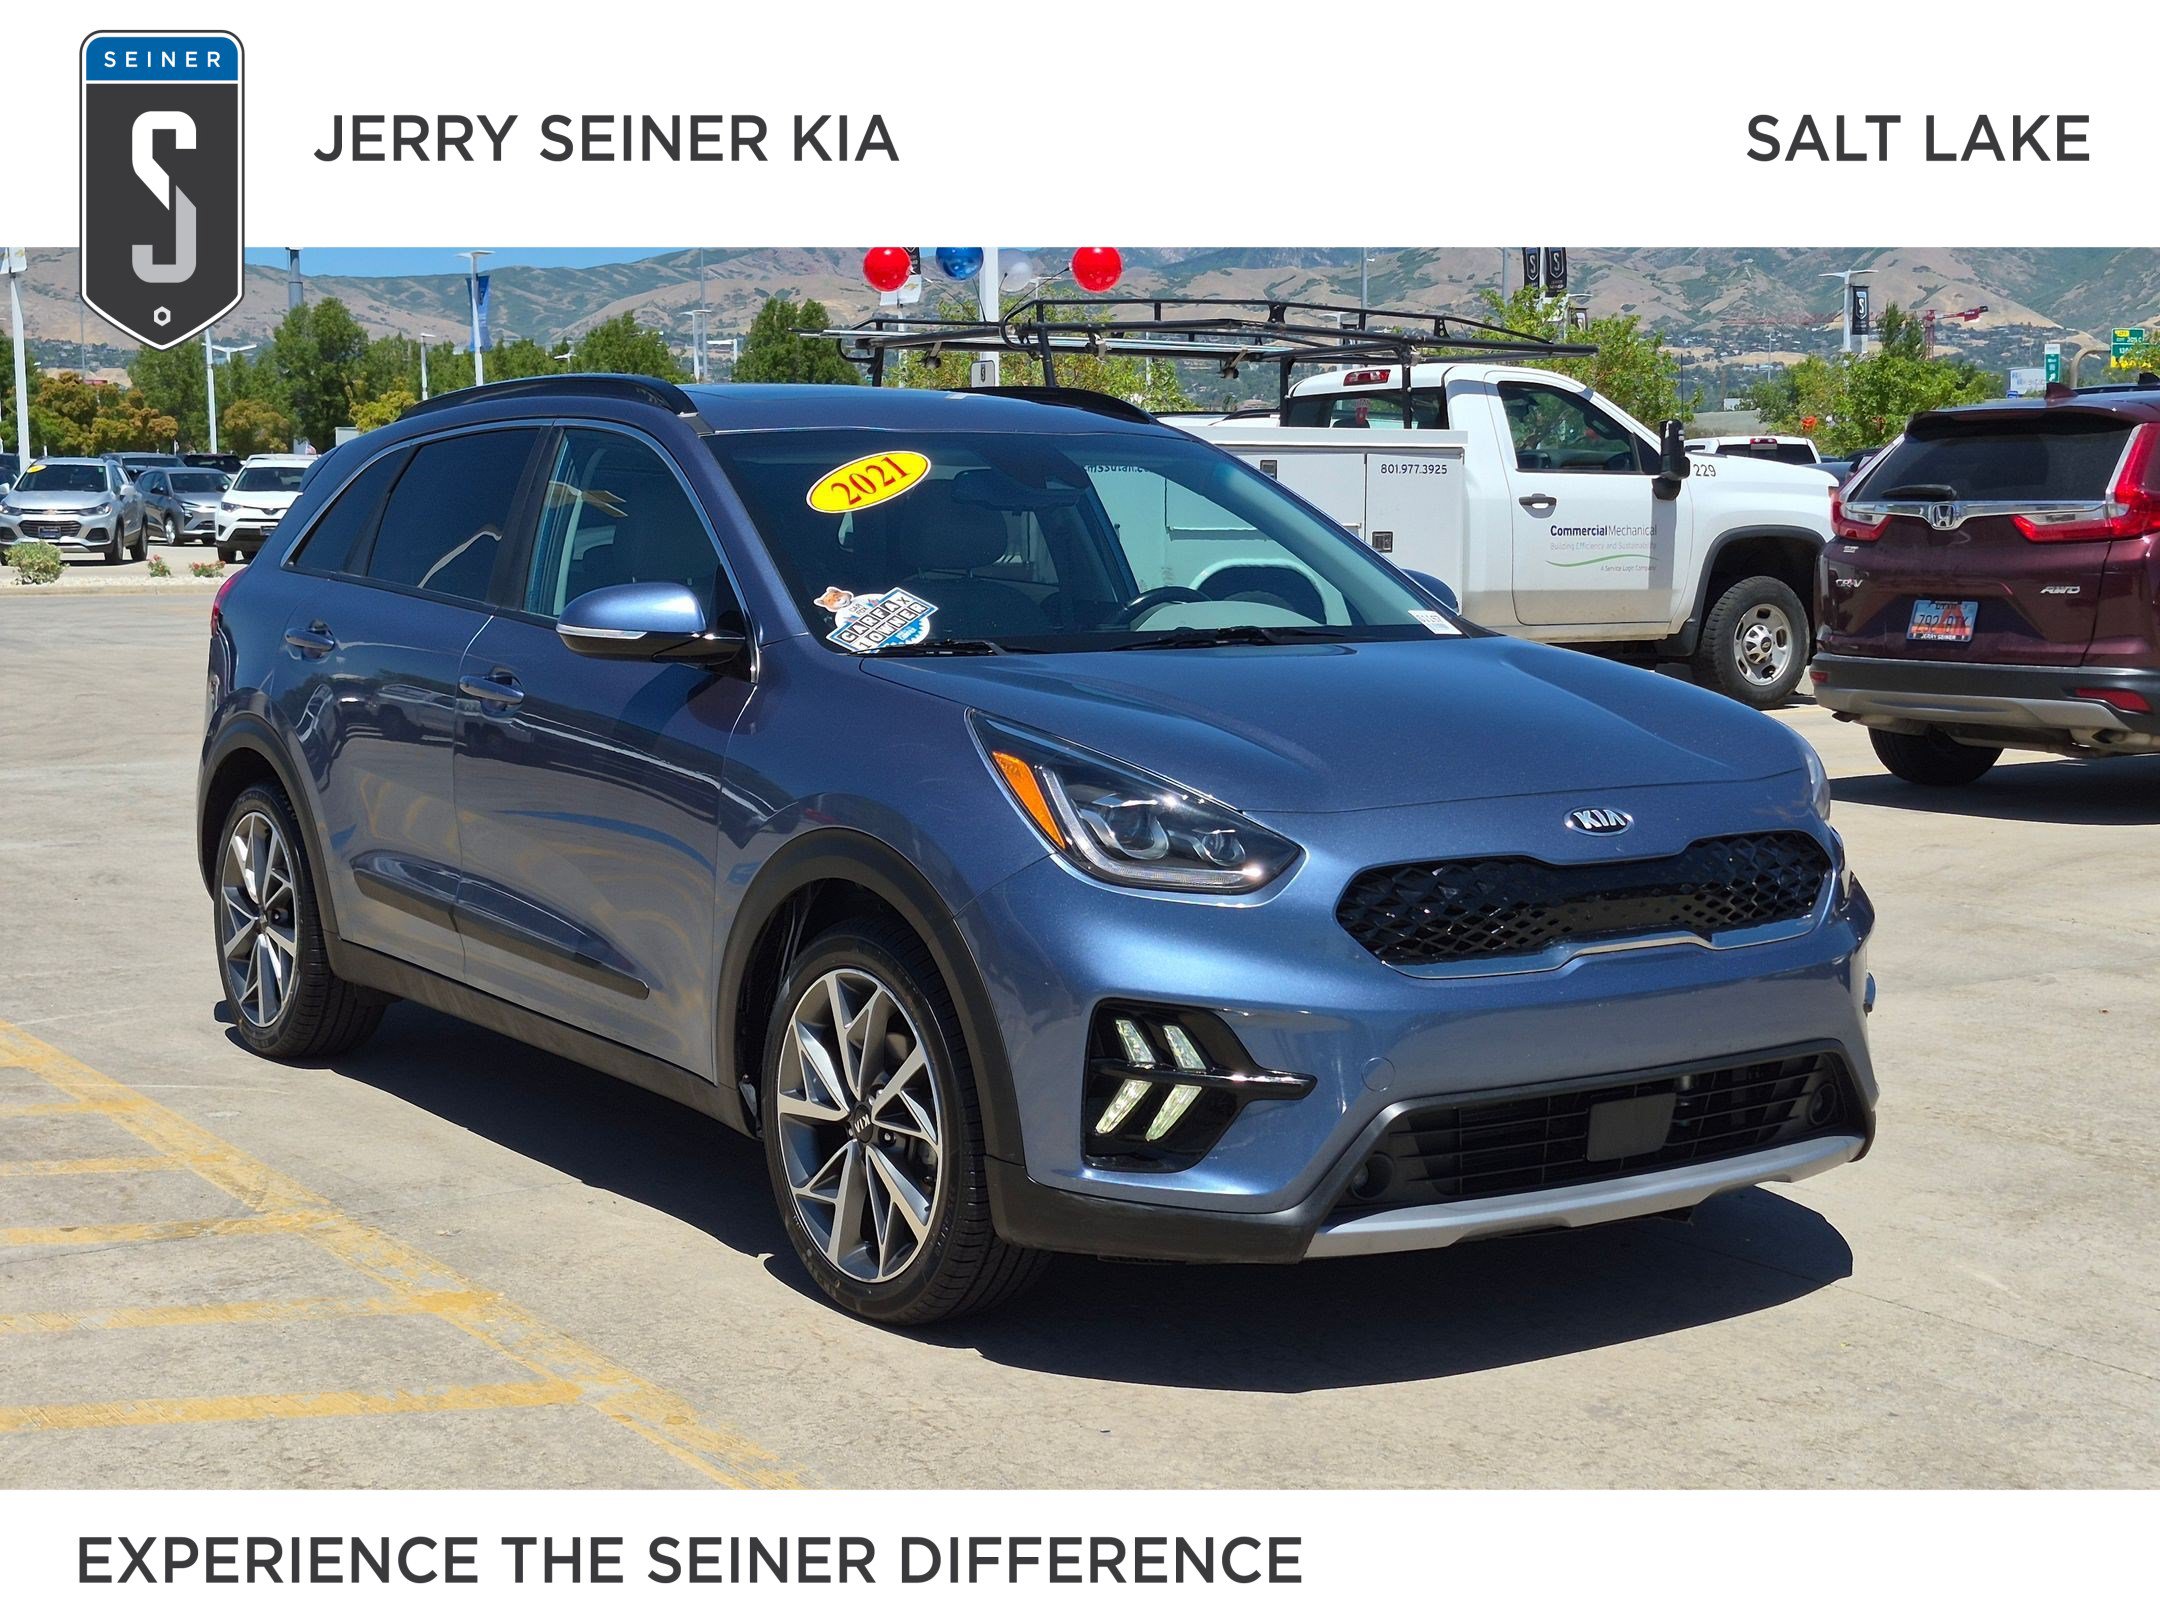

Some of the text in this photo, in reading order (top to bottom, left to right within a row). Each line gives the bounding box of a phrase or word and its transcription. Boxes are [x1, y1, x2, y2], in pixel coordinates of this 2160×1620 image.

[1380, 463, 1448, 475] 801.977.3925
[1692, 463, 1717, 477] 229
[831, 457, 910, 506] 2021
[2040, 585, 2080, 594] AWD
[837, 597, 910, 643] CARFAX
[866, 602, 928, 644] OWNER
[1573, 809, 1626, 830] KIA
[854, 1113, 871, 1134] KIA
